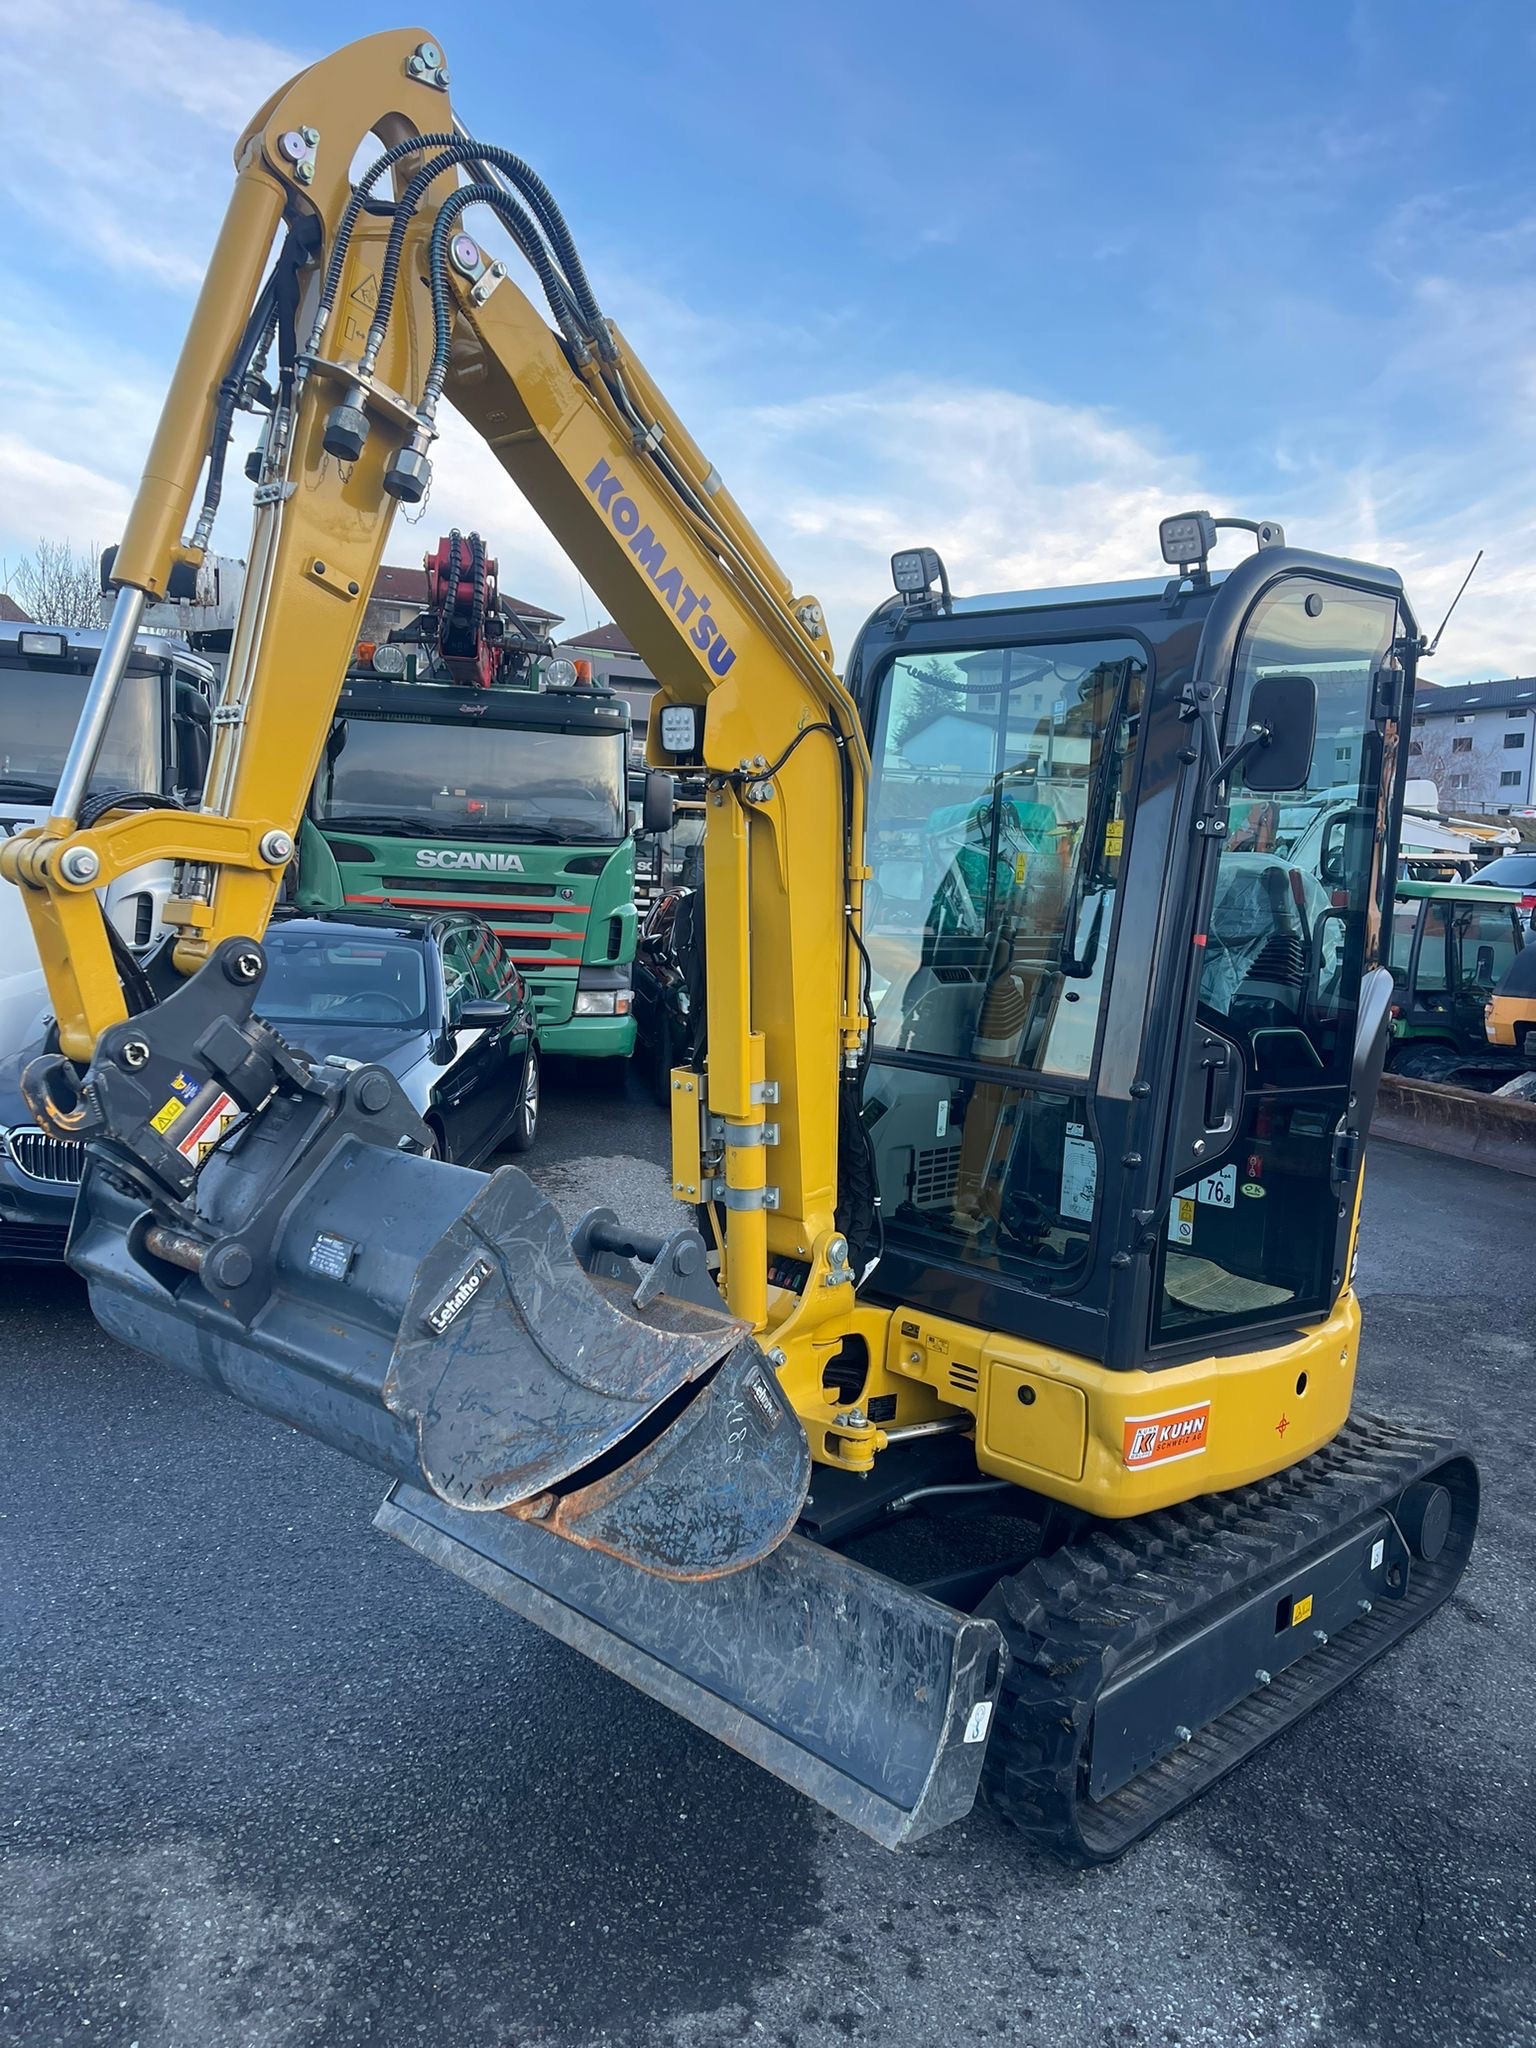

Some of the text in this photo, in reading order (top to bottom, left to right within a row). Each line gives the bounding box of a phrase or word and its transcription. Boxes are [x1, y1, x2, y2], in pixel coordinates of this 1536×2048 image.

[585, 456, 737, 677] KOMATSU
[416, 849, 525, 872] SCANIA
[636, 861, 684, 873] SCNIA
[1207, 1179, 1224, 1202] 76
[1245, 1184, 1261, 1193] OK
[1160, 1416, 1205, 1441] KUHN
[1156, 1432, 1203, 1451] SCHWEIZ AG
